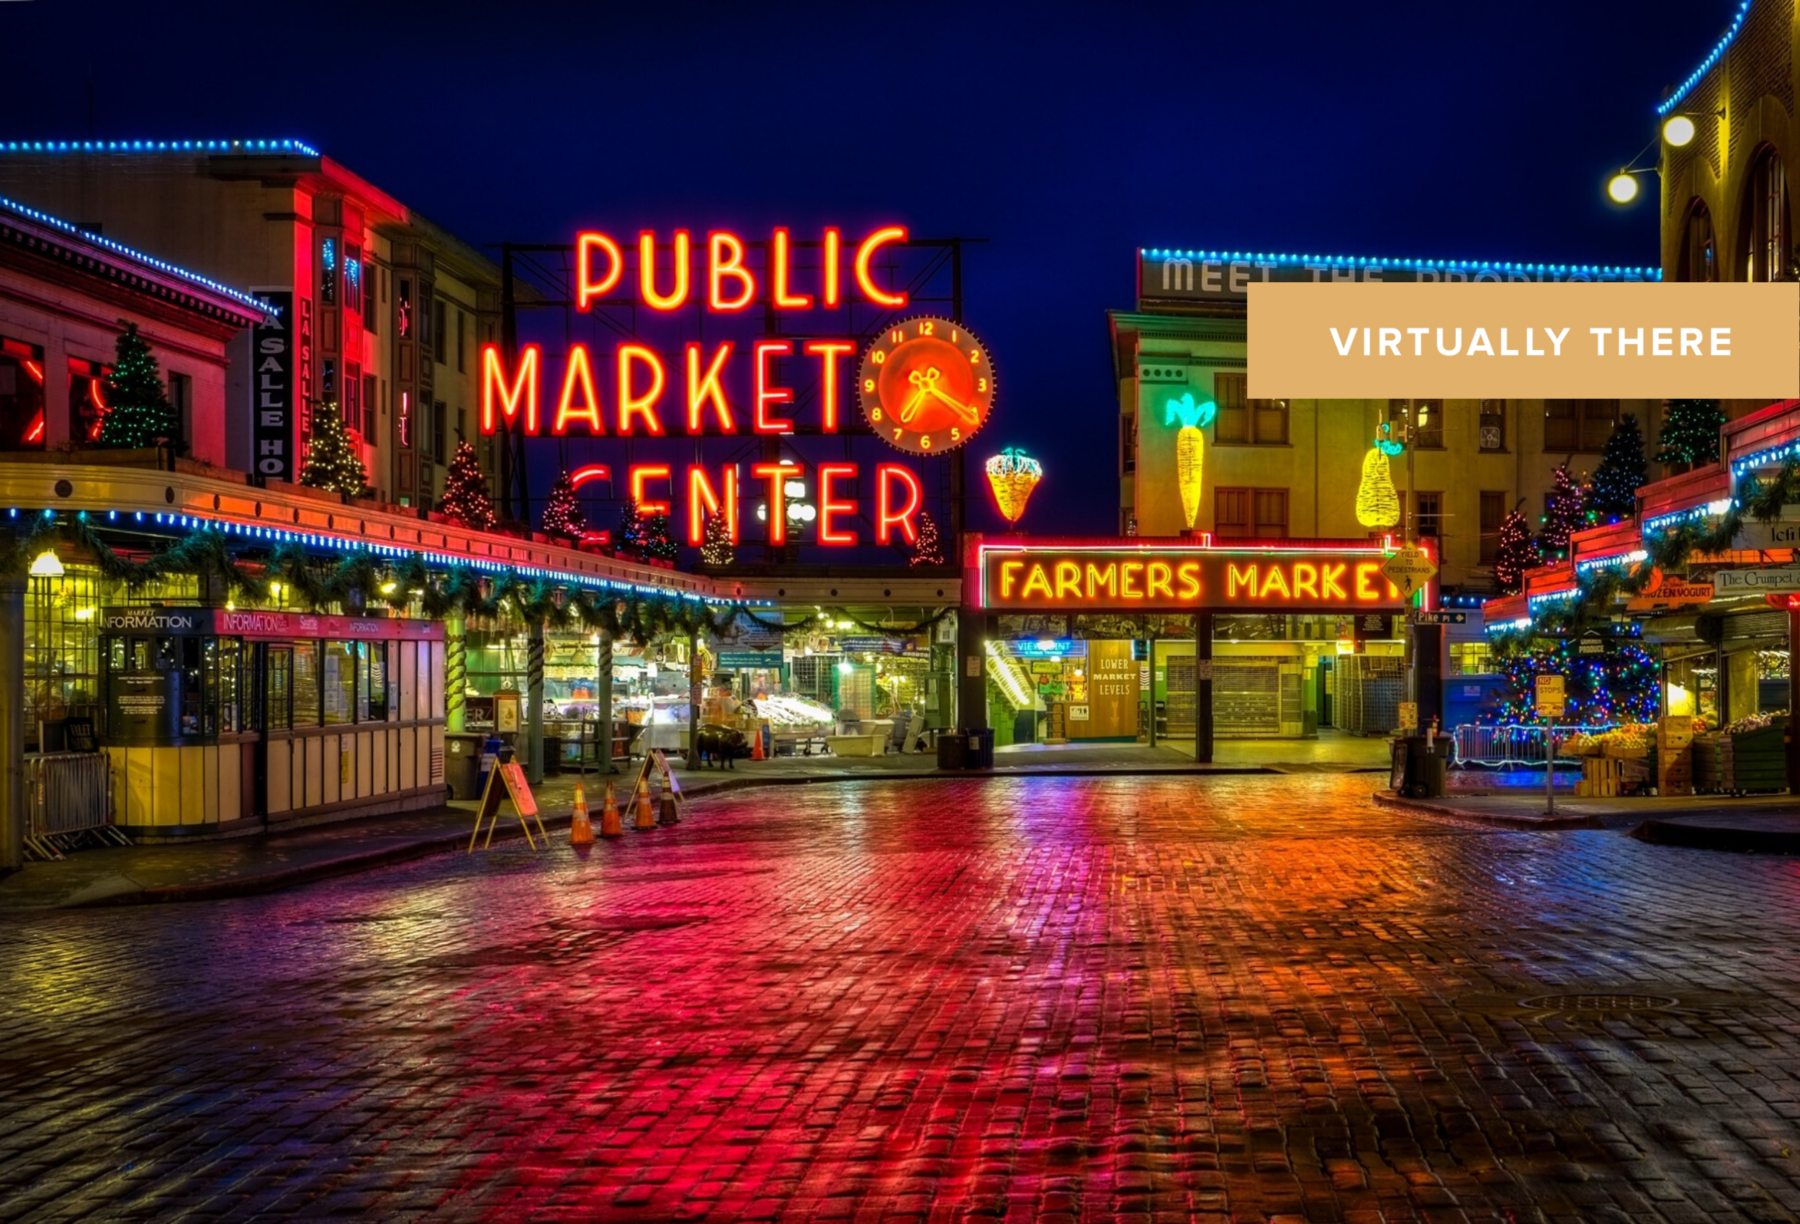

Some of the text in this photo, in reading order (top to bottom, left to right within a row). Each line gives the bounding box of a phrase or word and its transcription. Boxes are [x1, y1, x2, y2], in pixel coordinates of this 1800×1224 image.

[576, 226, 908, 313] PUBLIC
[1162, 257, 1277, 292] MEET
[919, 322, 933, 335] 12
[892, 330, 903, 343] 11
[952, 329, 957, 343] 1
[872, 351, 885, 363] 10
[970, 350, 979, 363] 2
[258, 337, 285, 427] SALLE
[480, 340, 857, 436] MARKET
[864, 379, 875, 392] 9
[978, 378, 987, 392] 3
[302, 346, 310, 432] SALLE
[872, 407, 882, 421] 8
[893, 428, 902, 440] 7
[951, 428, 960, 440] 5
[920, 435, 931, 449] 6
[258, 439, 284, 480] HO
[1001, 561, 1200, 599] FARMERS
[1719, 572, 1743, 587] The
[1744, 570, 1794, 587] Crumpet
[222, 613, 278, 632] INFORMATION
[1418, 612, 1439, 623] Pike
[1100, 658, 1129, 670] LOWER
[1093, 673, 1137, 681] MARKET
[1538, 677, 1550, 685] NO
[1099, 684, 1131, 696] LEVELS
[1538, 686, 1562, 694] STOPS
